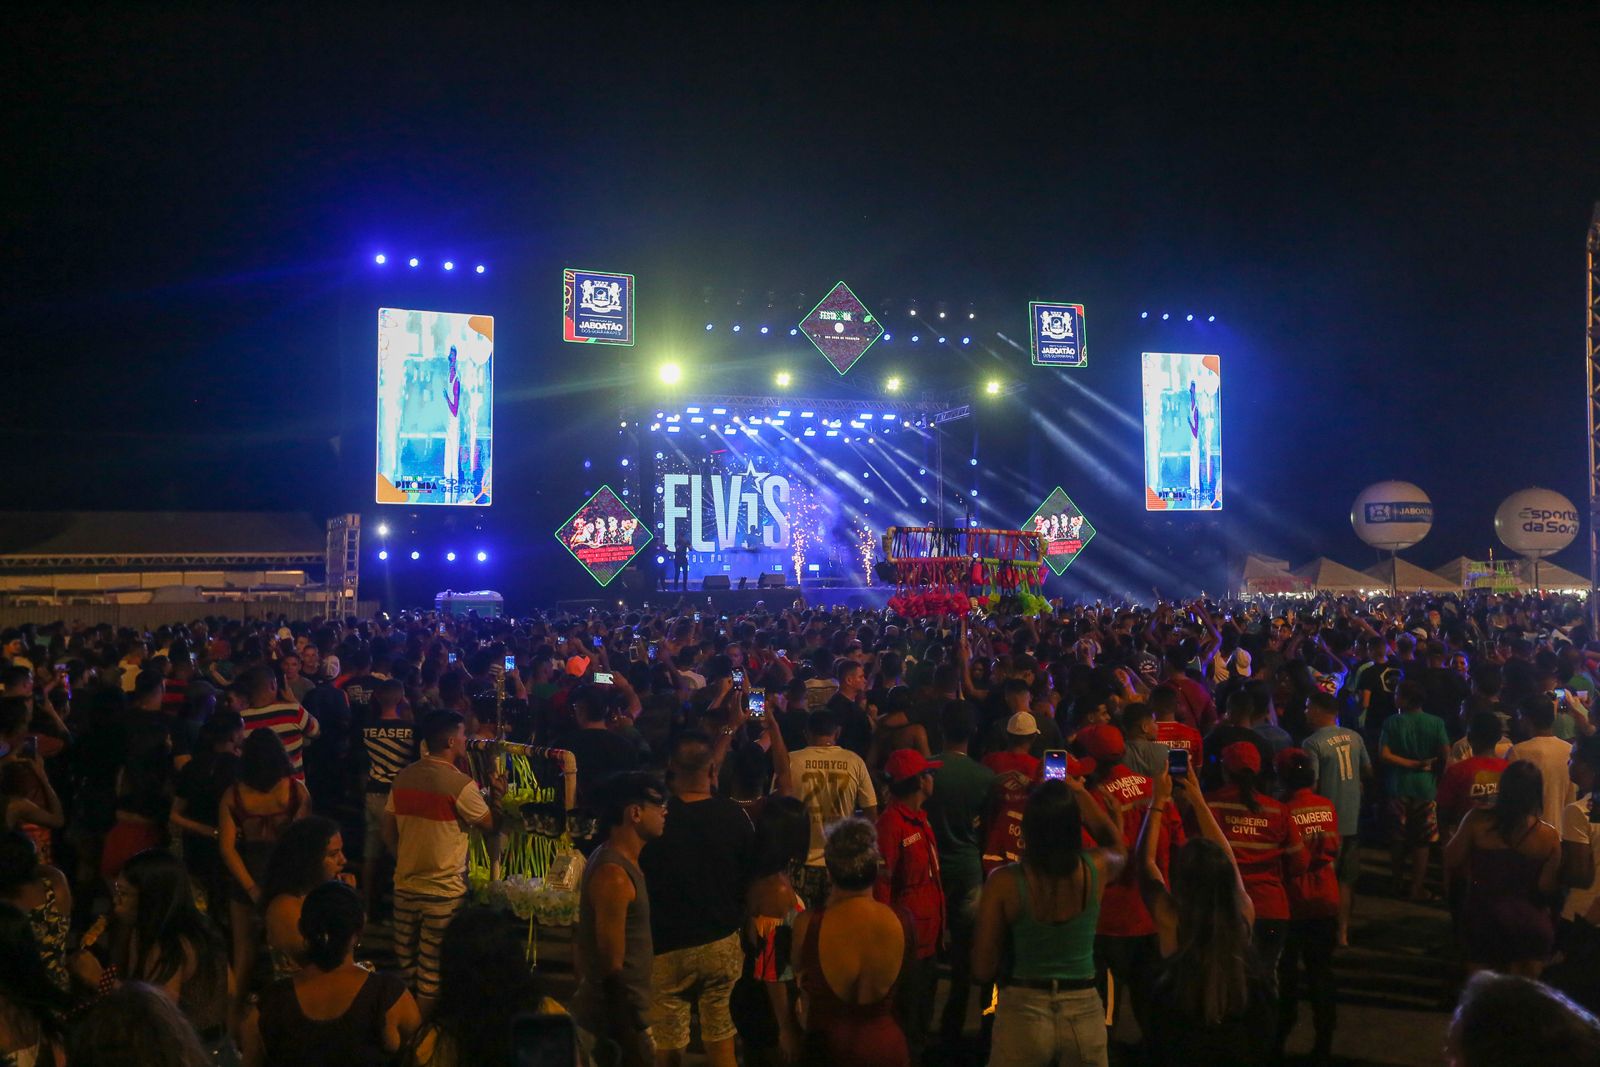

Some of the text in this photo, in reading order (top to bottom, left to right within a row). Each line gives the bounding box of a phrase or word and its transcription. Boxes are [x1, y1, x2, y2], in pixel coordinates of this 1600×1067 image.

[580, 322, 623, 331] JABOATÃO
[1042, 347, 1075, 355] JABOATÃO
[1399, 507, 1432, 516] JABOAT
[1546, 521, 1578, 535] Sort
[363, 728, 413, 738] TEASER
[805, 759, 848, 770] RODRYGO
[1336, 744, 1353, 781] 17
[1106, 775, 1147, 793] BOMBEIRO
[1121, 785, 1144, 799] CIVIL
[1225, 815, 1268, 827] BOMBEIRO
[1232, 825, 1260, 836] CIVIL
[1305, 824, 1326, 835] CIVIL
